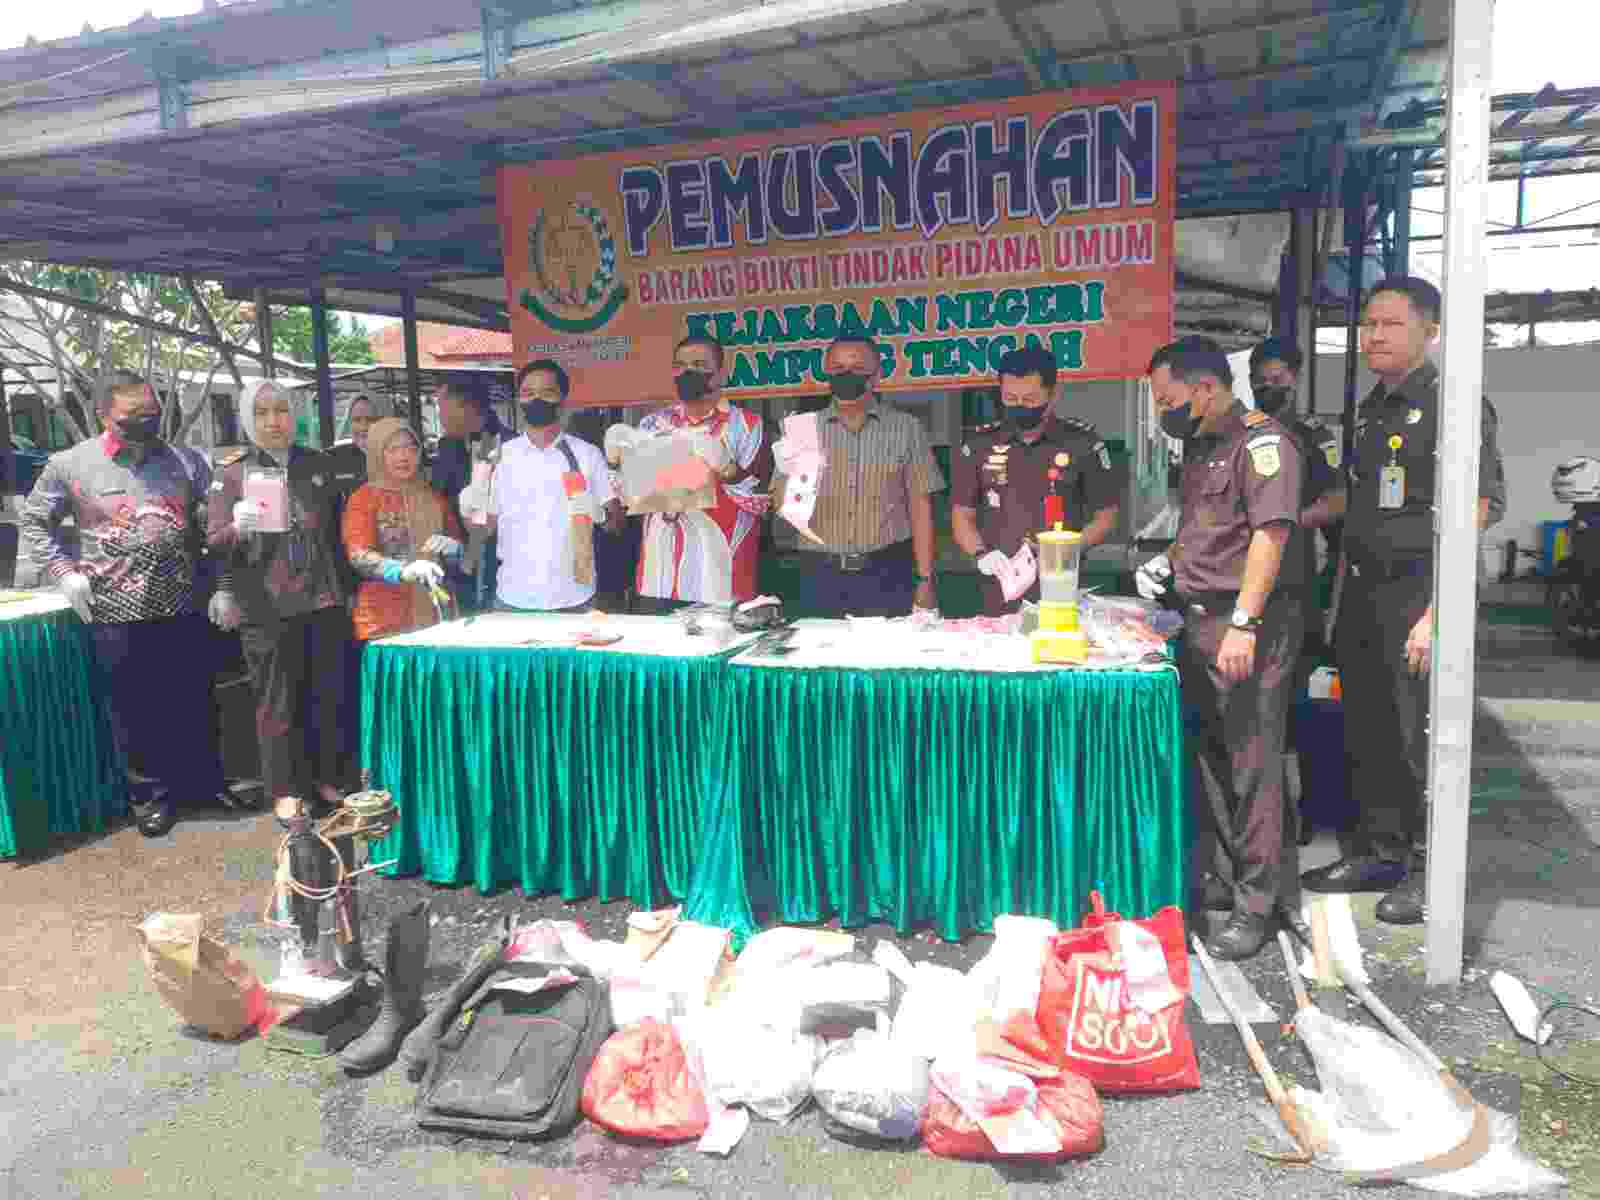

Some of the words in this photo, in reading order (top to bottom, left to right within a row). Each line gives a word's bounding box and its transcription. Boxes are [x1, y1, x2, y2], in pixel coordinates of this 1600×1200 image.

[618, 98, 1158, 256] PEMUSNAHAN
[638, 260, 737, 305] BARANG
[743, 251, 819, 297] BUKTI
[829, 241, 929, 290] TINDAK
[935, 229, 1042, 280] PIDANA
[1054, 220, 1154, 272] UMUM
[686, 296, 928, 350] KEJAKSAAN
[936, 281, 1105, 331] NEGERI
